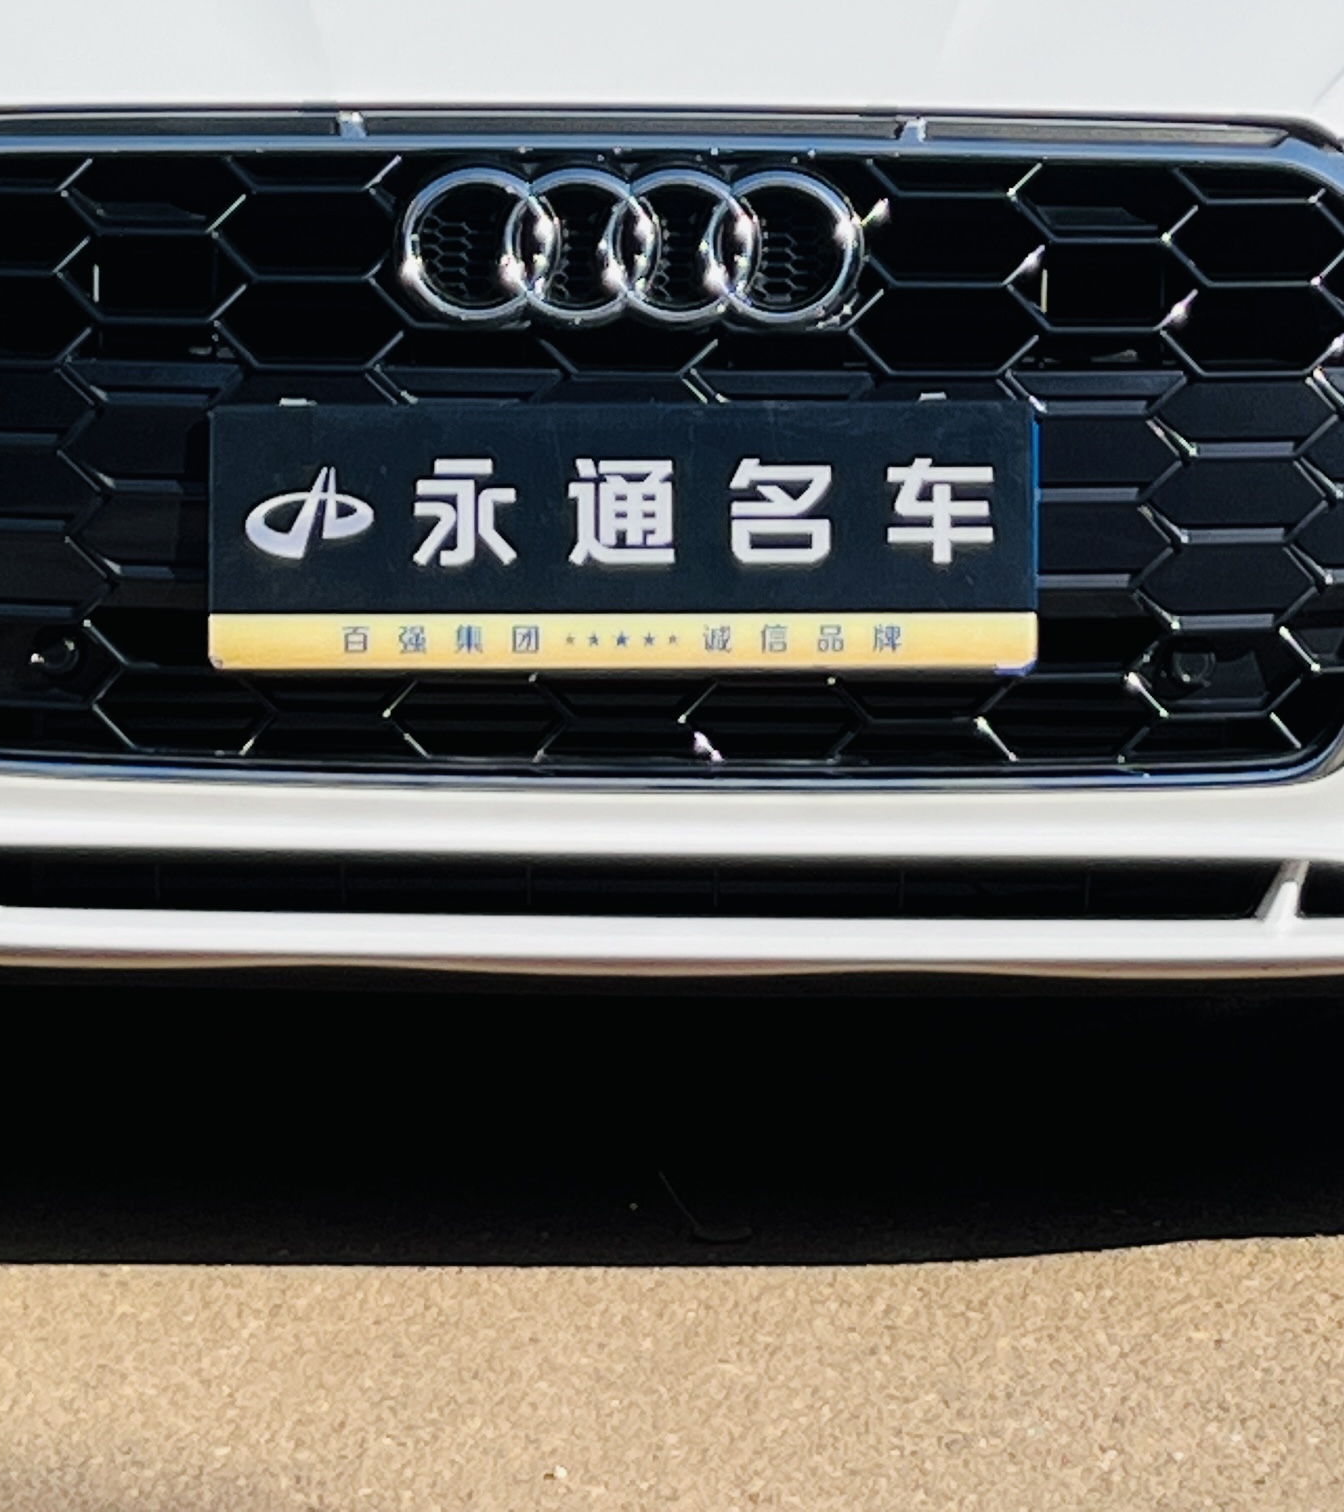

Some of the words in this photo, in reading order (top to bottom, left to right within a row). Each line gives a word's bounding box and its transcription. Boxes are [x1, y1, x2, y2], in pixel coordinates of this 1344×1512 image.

[413, 457, 994, 567] 永通名车
[342, 624, 540, 653] 百强集团
[703, 624, 902, 653] 诚信品牌
